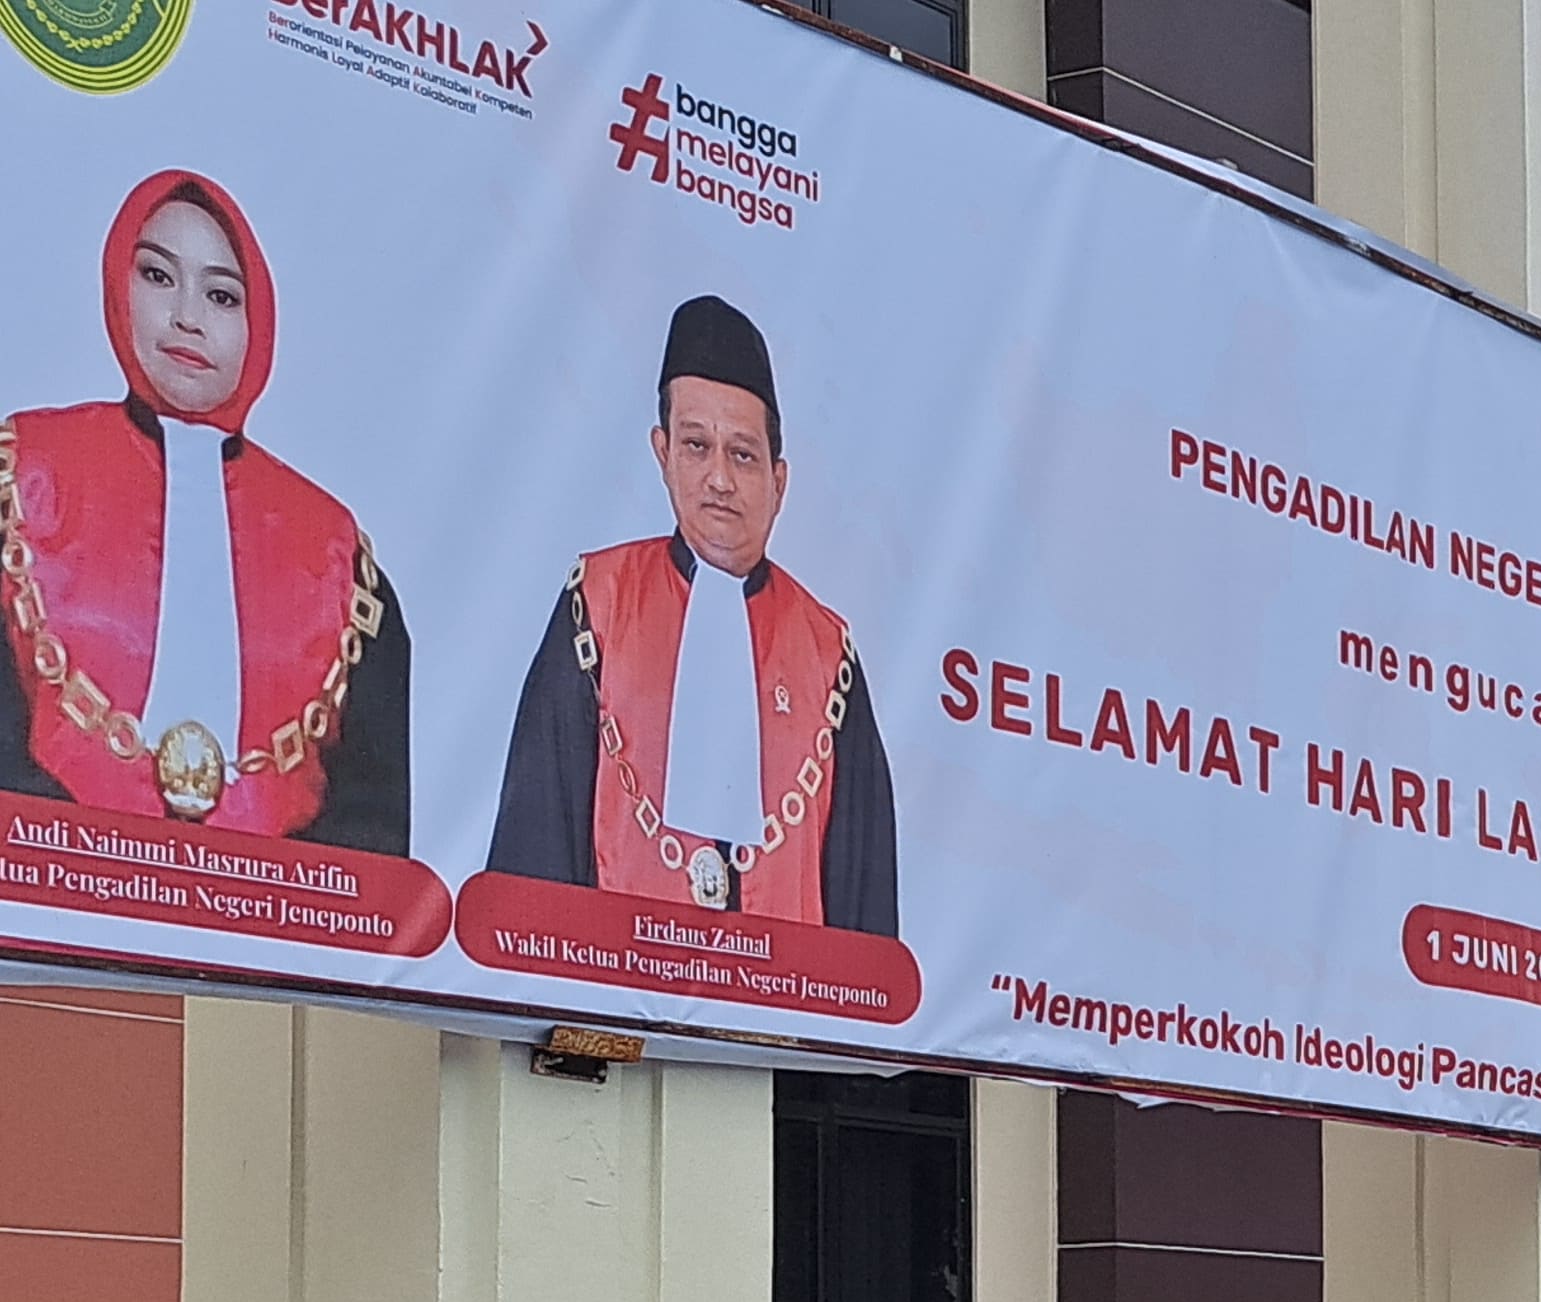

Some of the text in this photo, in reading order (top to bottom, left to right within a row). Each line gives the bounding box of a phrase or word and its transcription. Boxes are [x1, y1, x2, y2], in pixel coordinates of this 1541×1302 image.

[268, 11, 532, 120] Berorientasi Pelayanan Akuntabel Kompeten
[268, 28, 477, 114] Harmonis Loyal Adaptif Kolaboratif
[272, 0, 532, 98] erAKHLAK
[676, 83, 797, 157] bangga
[676, 159, 793, 229] bangsa
[677, 128, 818, 201] melayani
[1171, 429, 1435, 568] PENGADILAN
[941, 648, 1280, 793] SELAMAT
[1307, 743, 1451, 838] HARI
[8, 815, 357, 893] Andi Naimmi Masrura Arifin
[48, 863, 188, 907] Pengadilan
[196, 885, 273, 920] Negeri
[279, 900, 394, 937] Jeneponto
[634, 915, 771, 956] Firdaus Zainal
[496, 929, 887, 1008] Wakil Ketua Pengadilan Negeri Jeneponto
[1426, 929, 1441, 961] 1
[1452, 933, 1518, 976] JUNI
[1296, 1023, 1425, 1090] Ideologi
